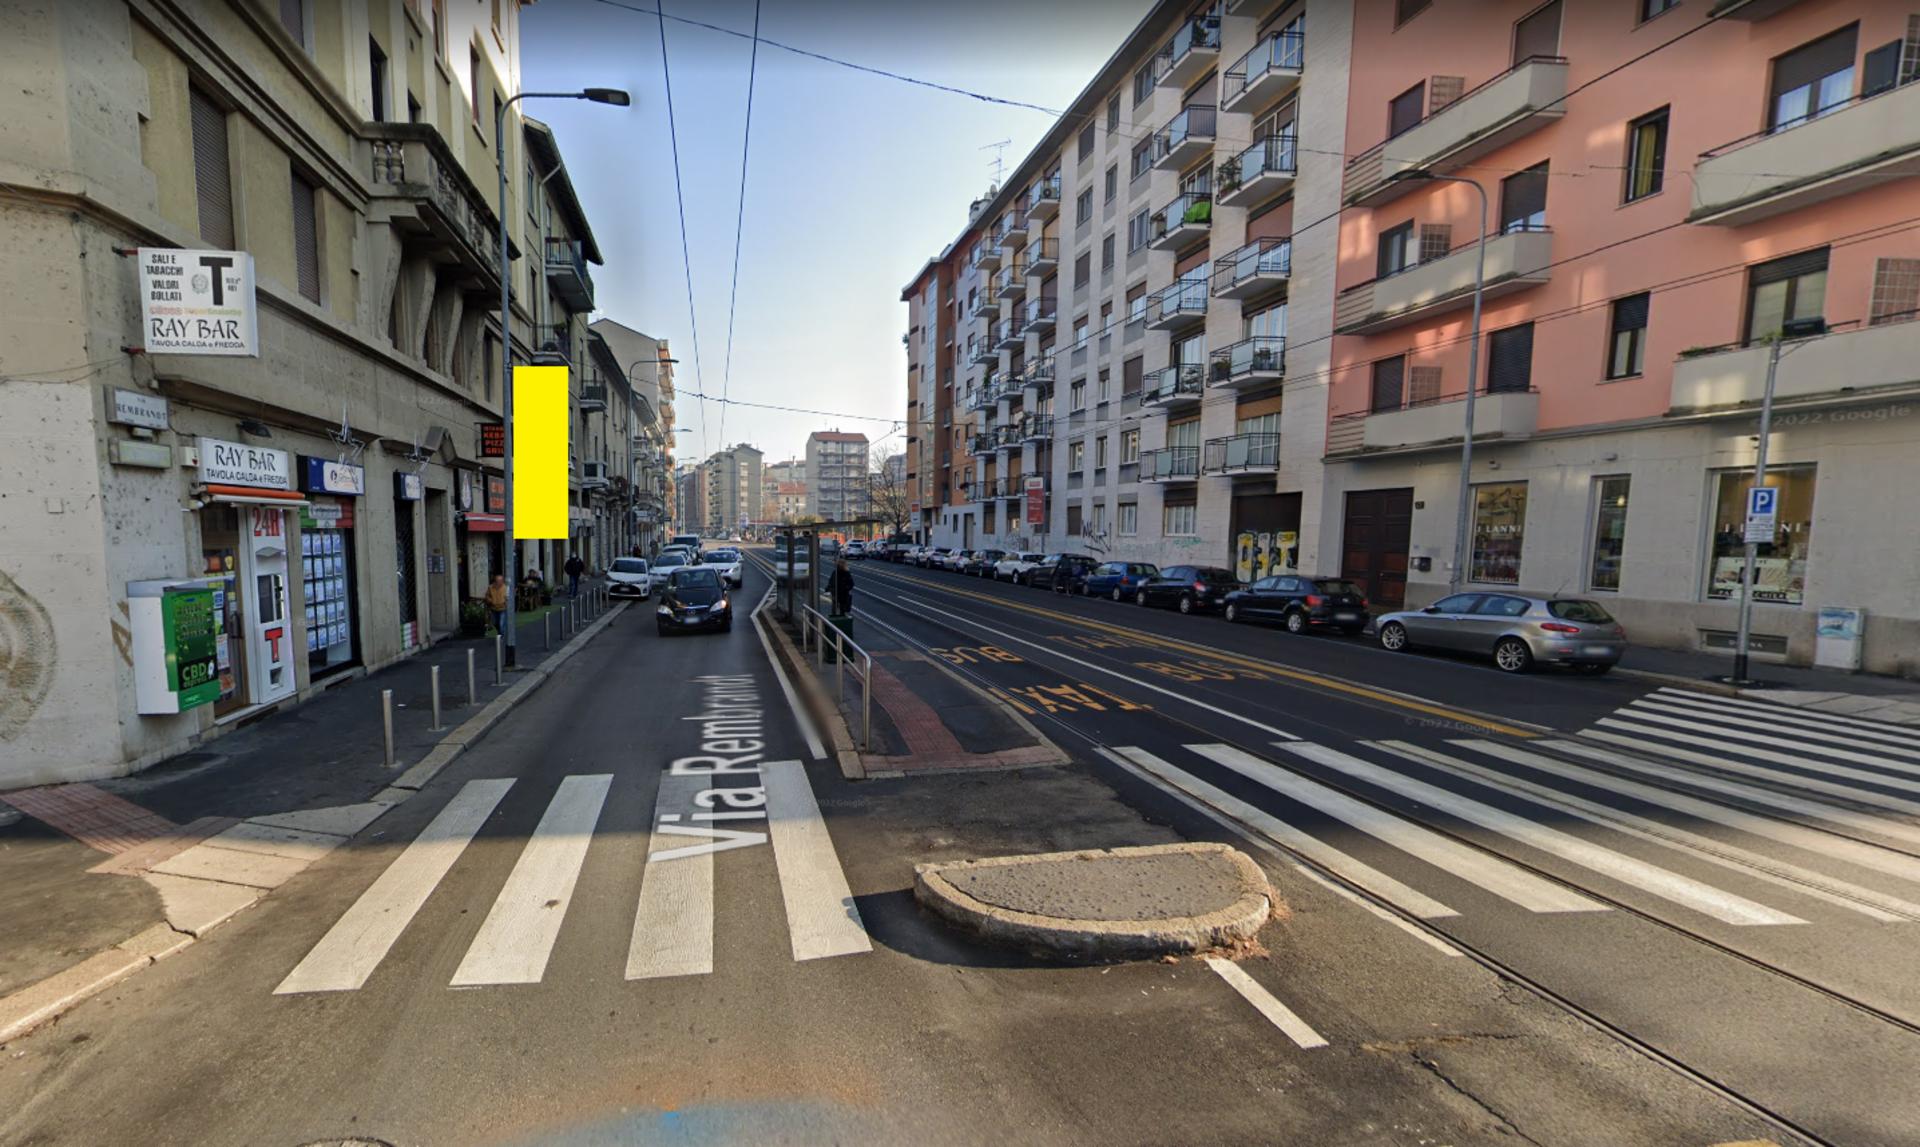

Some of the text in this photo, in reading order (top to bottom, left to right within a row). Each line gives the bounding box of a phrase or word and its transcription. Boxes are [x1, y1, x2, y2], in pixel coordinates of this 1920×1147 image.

[152, 254, 176, 264] SALI E
[145, 265, 184, 276] TABACCHI
[152, 280, 179, 289] VALORI
[199, 256, 233, 306] T
[151, 291, 182, 301] BOLLATI
[150, 317, 240, 339] RAY BAR
[182, 340, 206, 348] CALDA
[116, 403, 167, 420] REMBRANDT
[215, 445, 276, 472] RAY BAR
[206, 468, 235, 480] TAVOLA
[236, 470, 258, 482] CALDA
[264, 473, 288, 485] FREDDA
[1755, 491, 1770, 511] P
[252, 508, 281, 537] 24H
[265, 627, 283, 663] T
[182, 662, 207, 680] CBD
